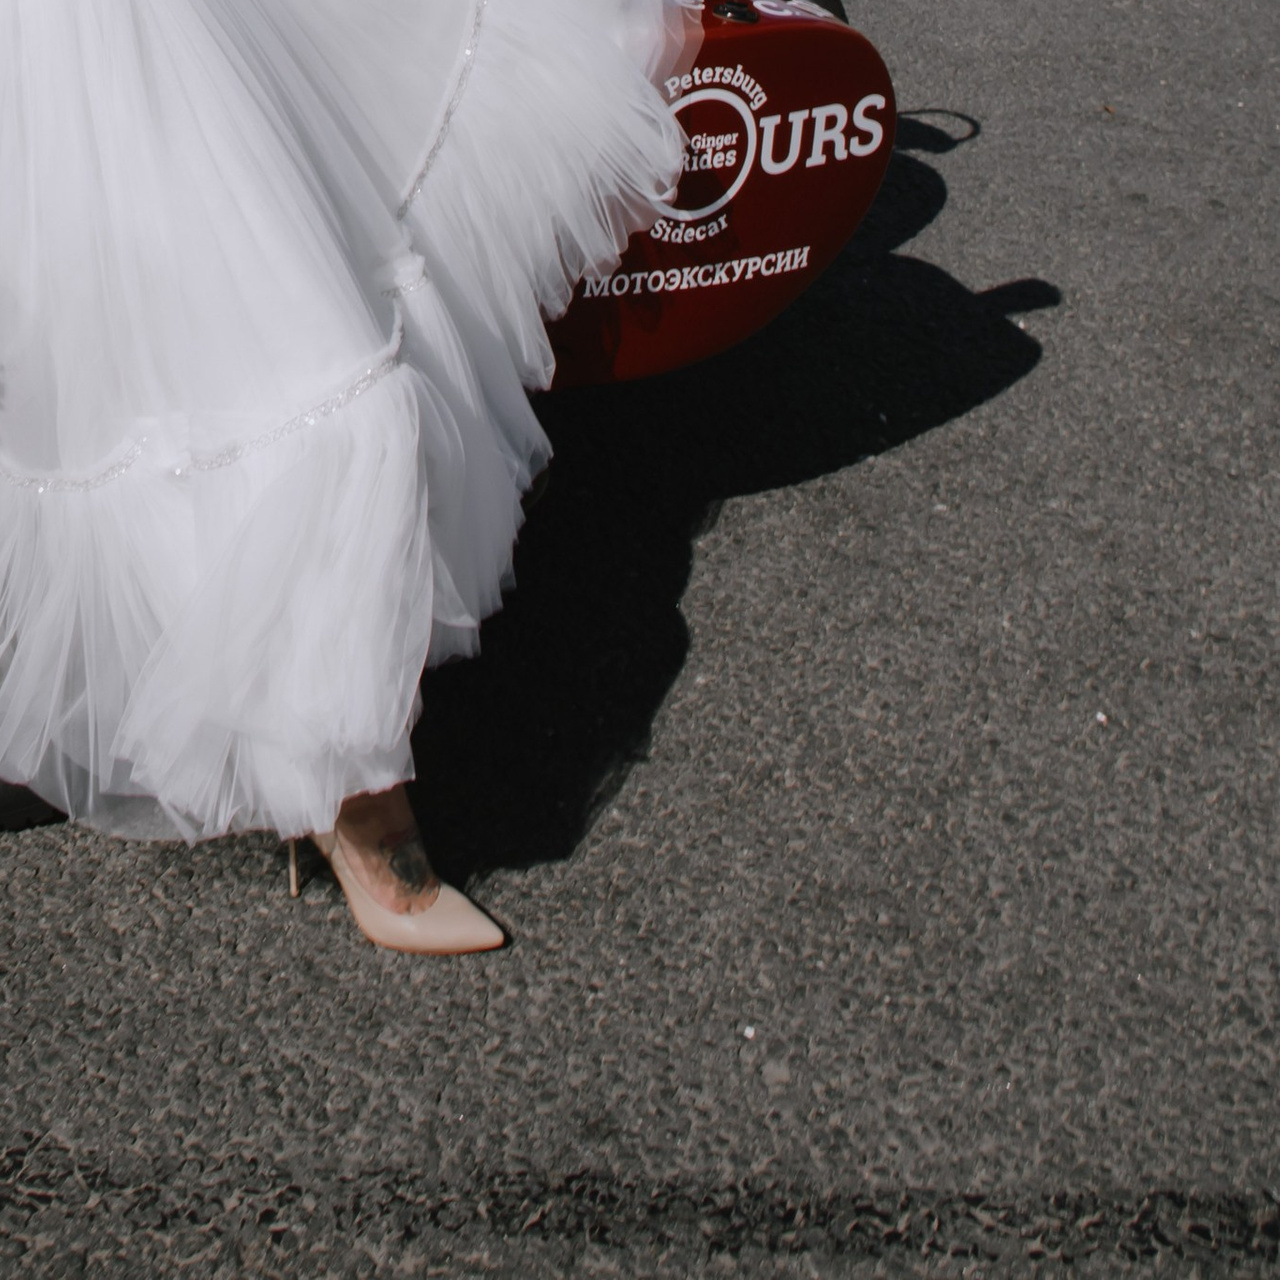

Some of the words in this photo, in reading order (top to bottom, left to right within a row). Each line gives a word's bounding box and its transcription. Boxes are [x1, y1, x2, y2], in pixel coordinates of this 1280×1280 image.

[664, 64, 768, 111] Petersburg
[691, 132, 738, 150] Ginger
[650, 212, 728, 243] Sidecar
[583, 246, 810, 298] МОТОЭКСКУРСИИ
